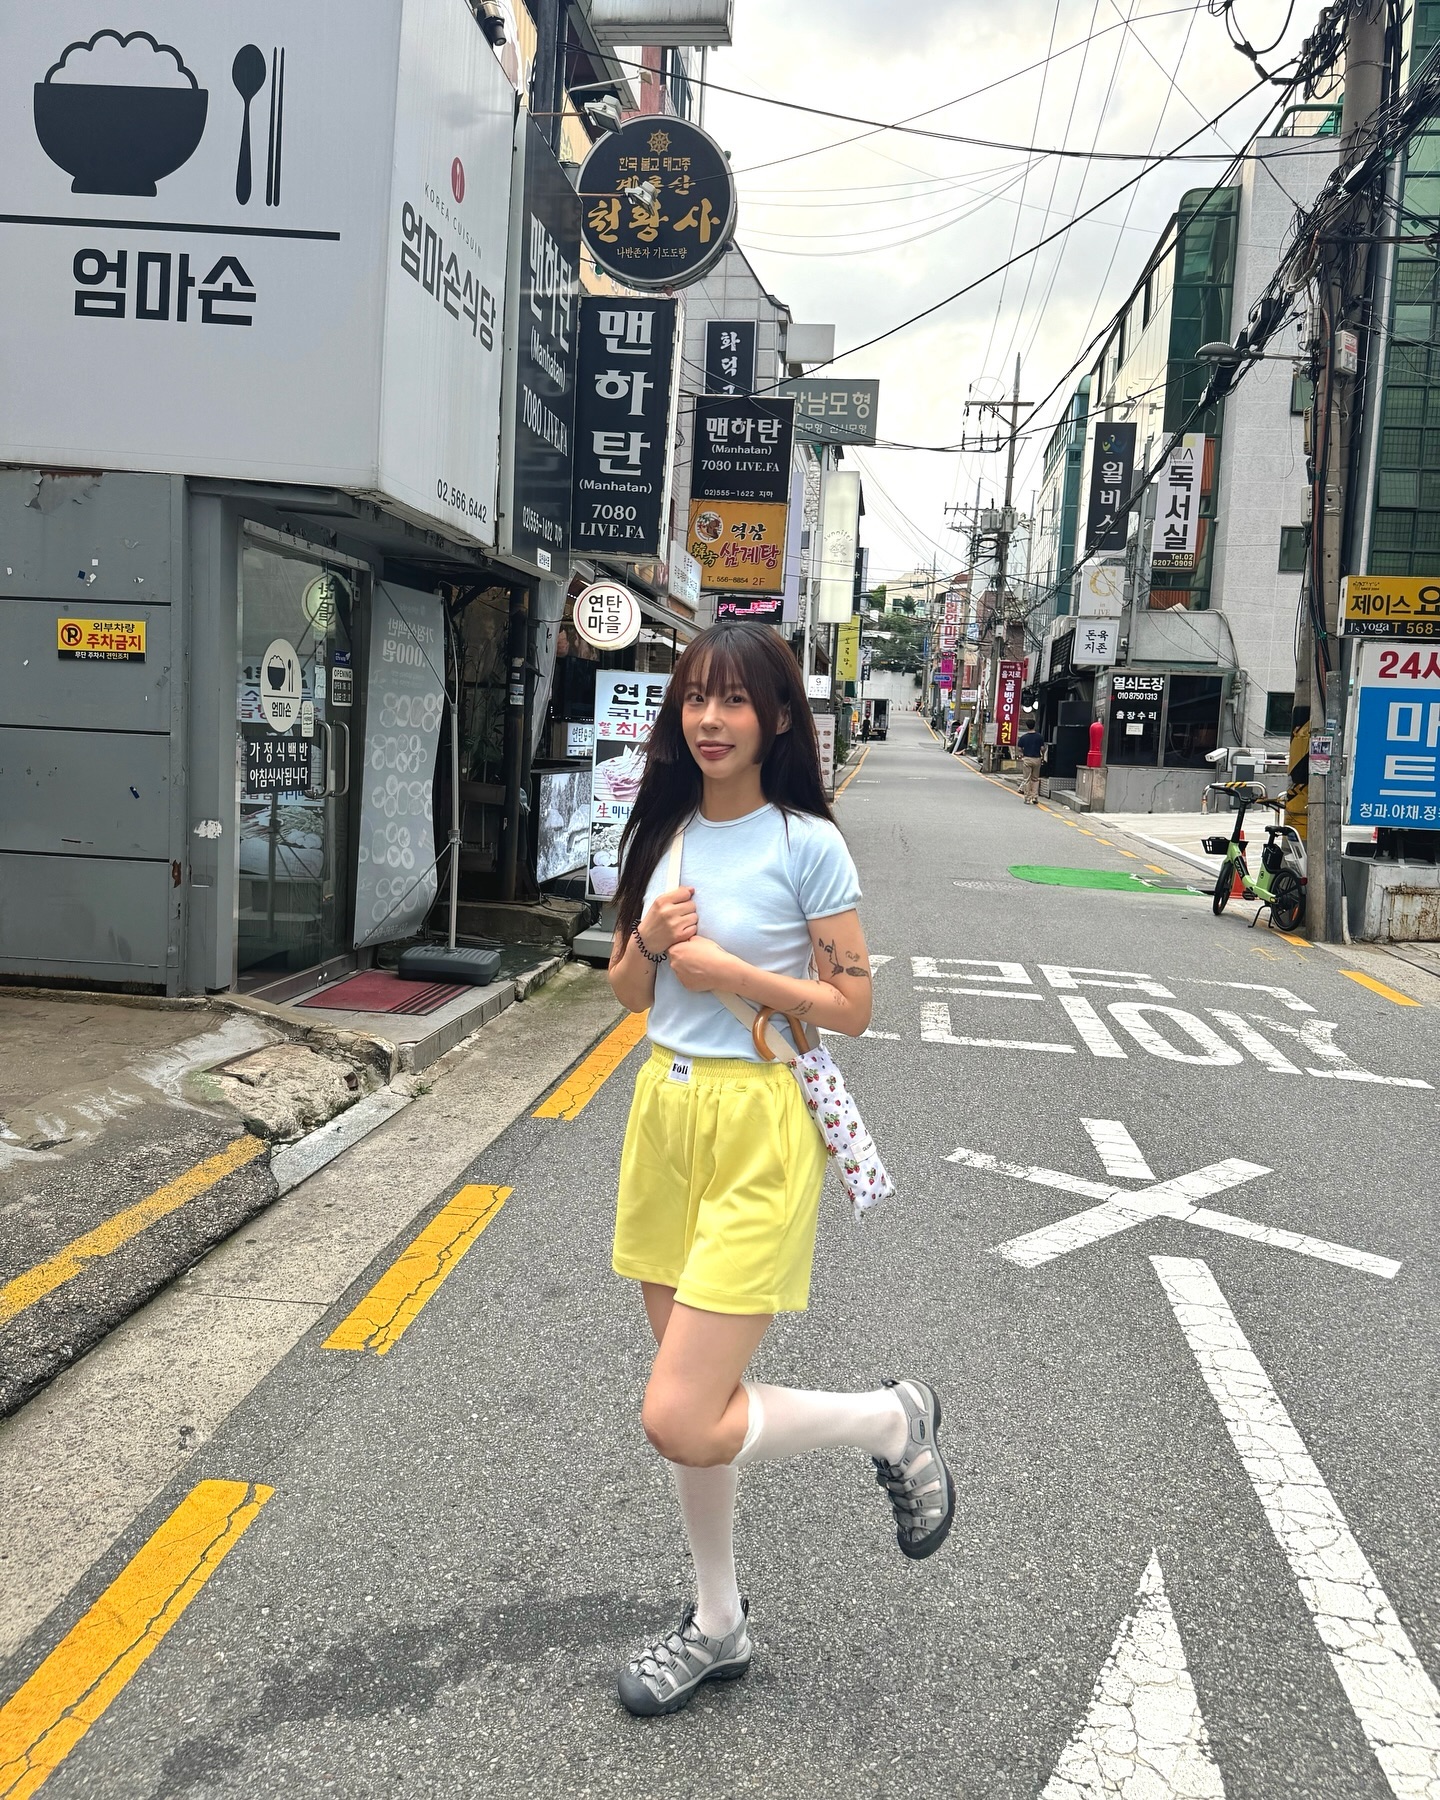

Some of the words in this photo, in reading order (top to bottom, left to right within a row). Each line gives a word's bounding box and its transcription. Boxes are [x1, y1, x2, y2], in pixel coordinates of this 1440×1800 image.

[618, 156, 638, 172] 한국
[640, 156, 660, 172] 불교
[662, 156, 690, 172] 태고종
[424, 182, 450, 222] KOREA
[653, 247, 688, 260] 기도도량
[400, 201, 496, 352] 엄마손식당
[530, 212, 573, 353] 맨하탄
[73, 248, 256, 326] 엄마손
[530, 326, 566, 392] (Manhatan)
[591, 310, 656, 476] 맨하탄
[523, 384, 542, 436] 7080
[706, 418, 782, 444] 맨하탄
[712, 444, 772, 456] (Manhatan)
[702, 460, 732, 471] 7080
[736, 462, 780, 472] LIVE.FA
[579, 478, 652, 494] (Manhatan)
[704, 489, 755, 497] 02)555-1622
[437, 479, 487, 524] 02.566.6442
[1095, 461, 1124, 534] 월비스
[592, 504, 637, 520] 7080
[1164, 466, 1194, 550] 독서실
[580, 522, 646, 540] LIVE.FA
[731, 522, 767, 541] 역삼
[720, 542, 781, 569] 삼계탕
[752, 578, 766, 586] 2F
[588, 594, 622, 613] 연탄
[92, 622, 136, 634] 외부차량
[588, 615, 622, 634] 마을
[1361, 622, 1390, 634] yoga
[1392, 622, 1402, 634] T
[86, 634, 142, 650] 주차금지
[1085, 629, 1109, 642] 돈육
[1084, 642, 1108, 654] 지존
[1112, 676, 1165, 691] 열쇠도장
[1003, 679, 1016, 715] 골뱅이
[272, 702, 292, 718] 엄마손
[1116, 710, 1157, 720] 출장수리
[1001, 721, 1012, 744] 치킨
[250, 766, 308, 788] 아침식사됩니다
[595, 803, 612, 818] 生
[612, 806, 632, 819] 미나
[864, 954, 1435, 1090] 진입금
